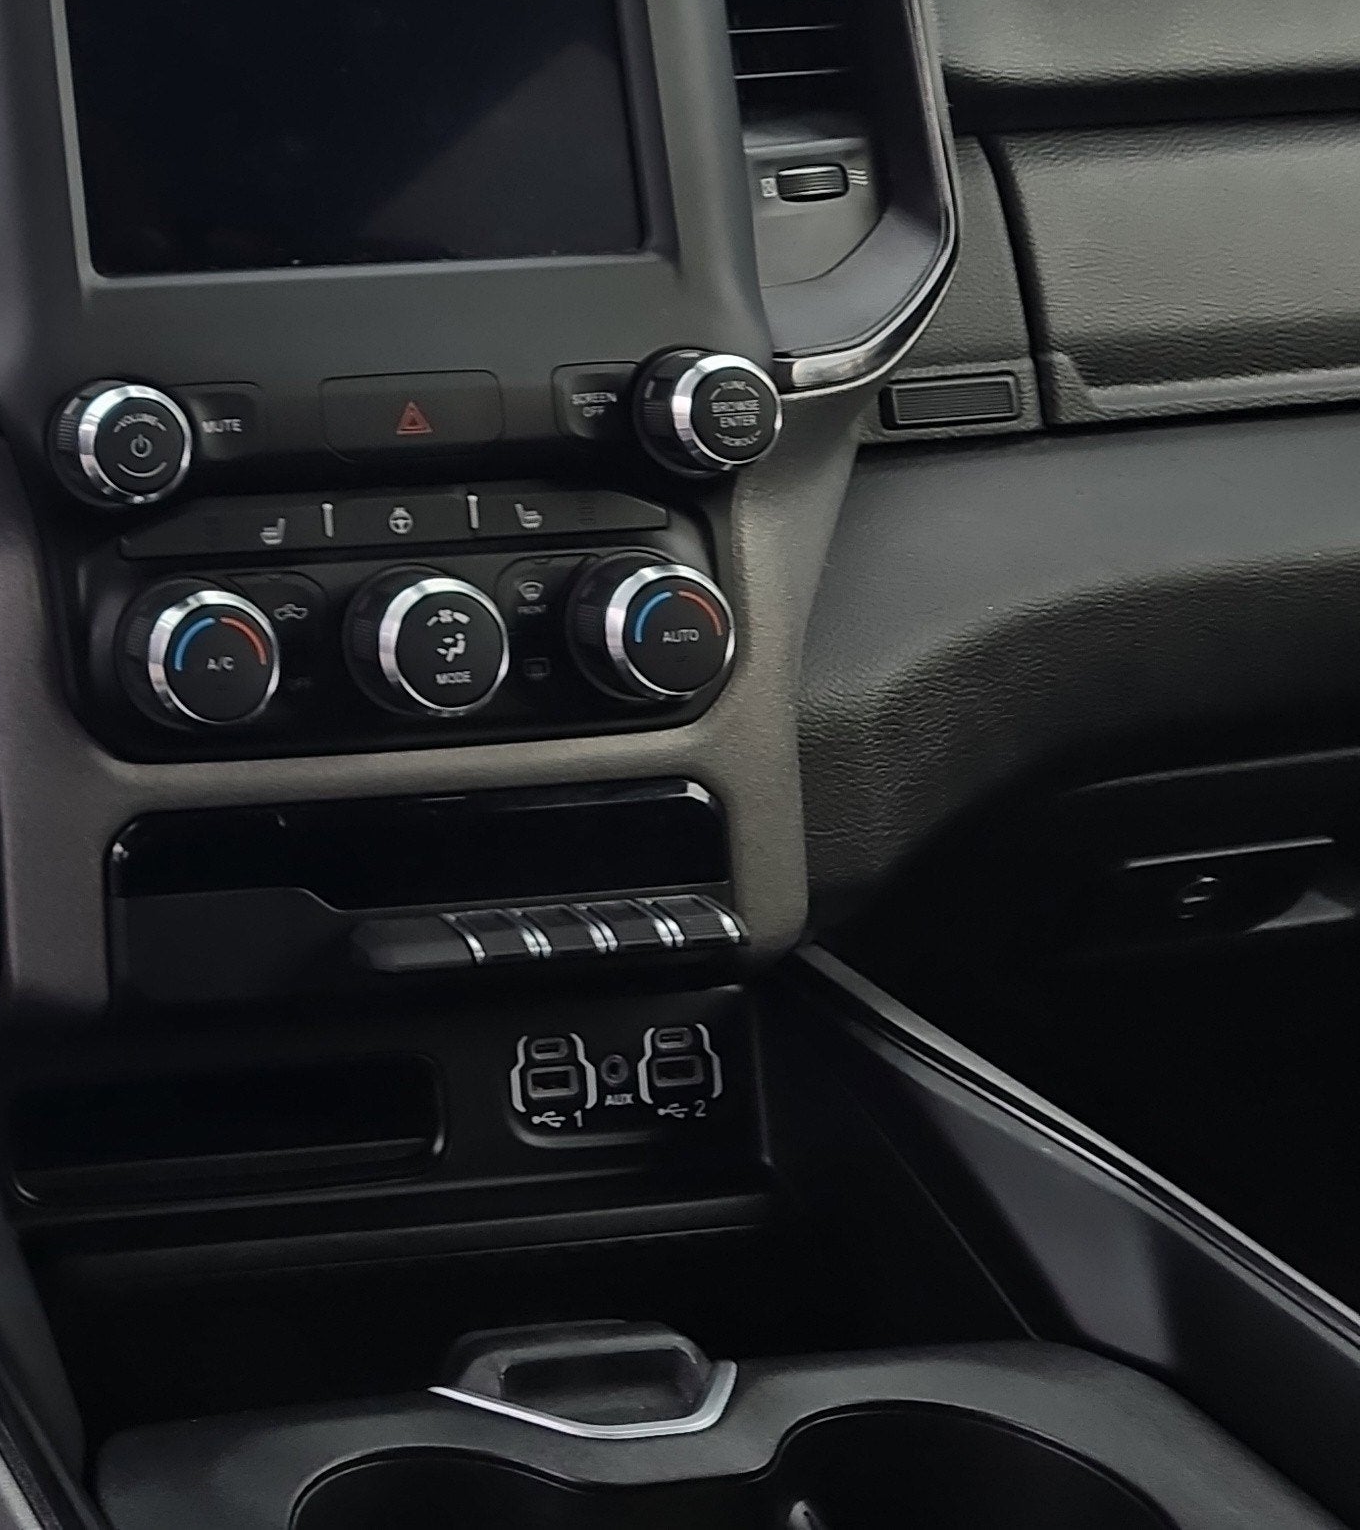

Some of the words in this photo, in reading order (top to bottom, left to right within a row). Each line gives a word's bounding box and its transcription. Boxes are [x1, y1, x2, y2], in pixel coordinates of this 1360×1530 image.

[201, 418, 243, 433] MUTE
[719, 415, 757, 428] ENTER
[662, 628, 700, 643] AUTO
[694, 1099, 707, 1117] 2
[573, 1109, 583, 1128] 1
